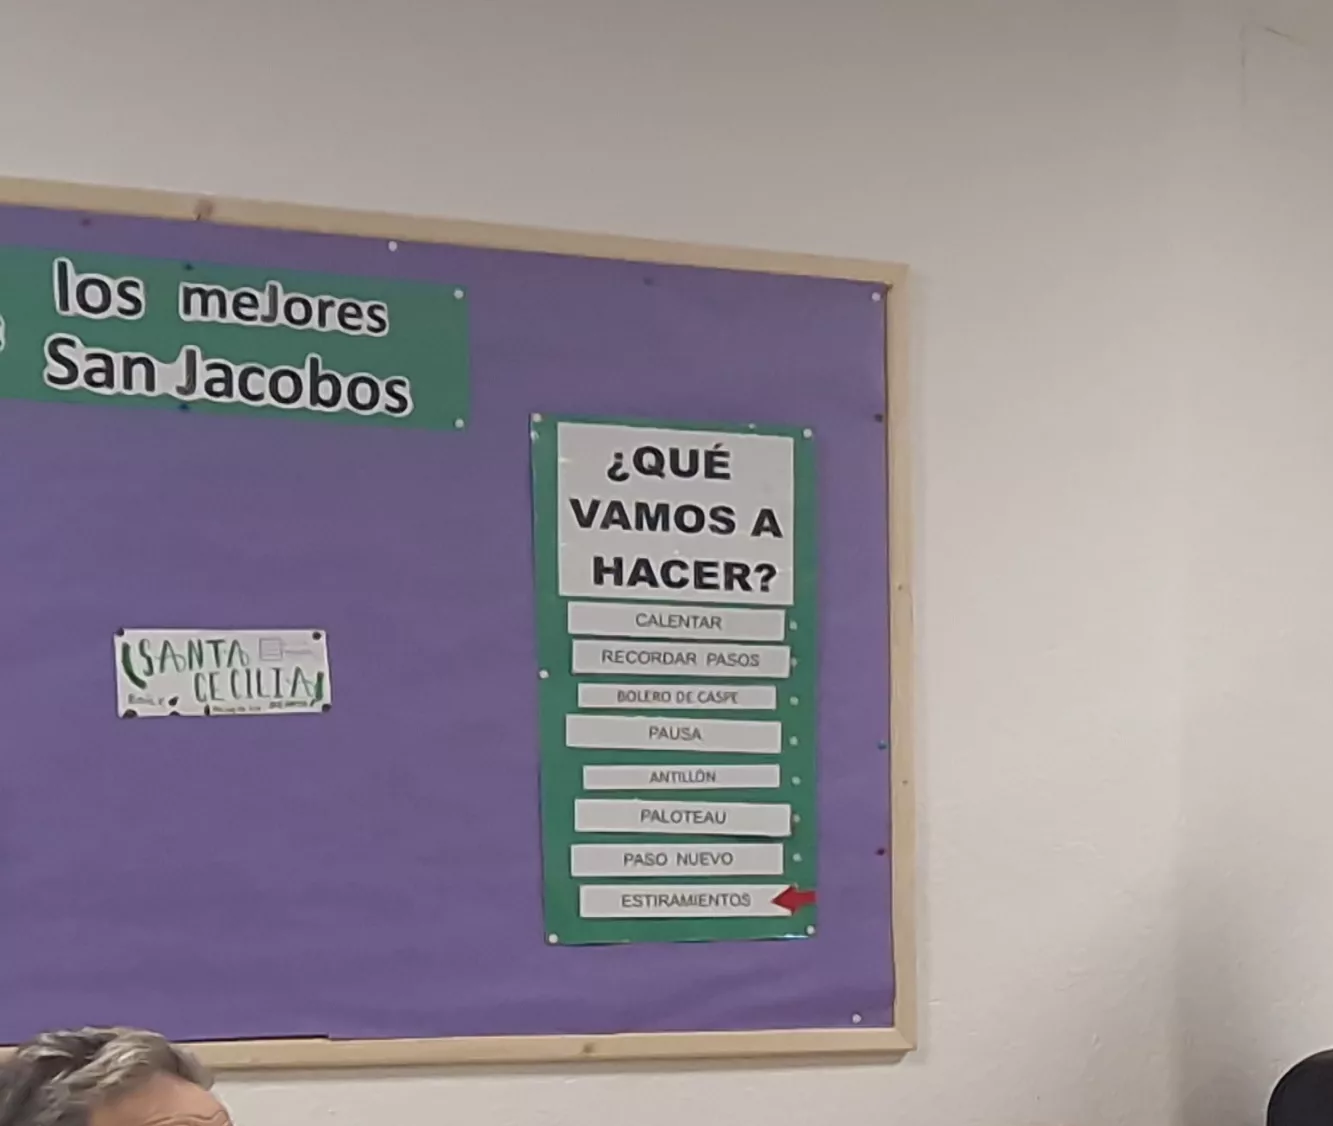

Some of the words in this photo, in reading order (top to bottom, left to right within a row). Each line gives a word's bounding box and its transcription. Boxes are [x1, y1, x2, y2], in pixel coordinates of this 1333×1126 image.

[56, 261, 143, 316] los
[46, 337, 156, 392] San
[176, 347, 410, 415] Jacobos
[607, 443, 731, 482] ¿QUÉ
[569, 498, 736, 535] VAMOS
[750, 508, 783, 538] A
[592, 555, 777, 593] HACER?
[635, 612, 722, 630] CALENTAR
[138, 638, 250, 676] SANTA
[601, 649, 697, 665] RECORDAR
[706, 652, 760, 667] PASOS
[617, 689, 671, 703] BOLERO
[676, 690, 693, 703] DE
[697, 690, 738, 704] CASPE
[648, 726, 702, 741] PAUSA
[640, 808, 727, 824] PALOTEAU
[623, 851, 668, 866] PASO
[676, 851, 734, 866] NUEVO
[621, 893, 751, 908] ESTIRAMIENTOS
